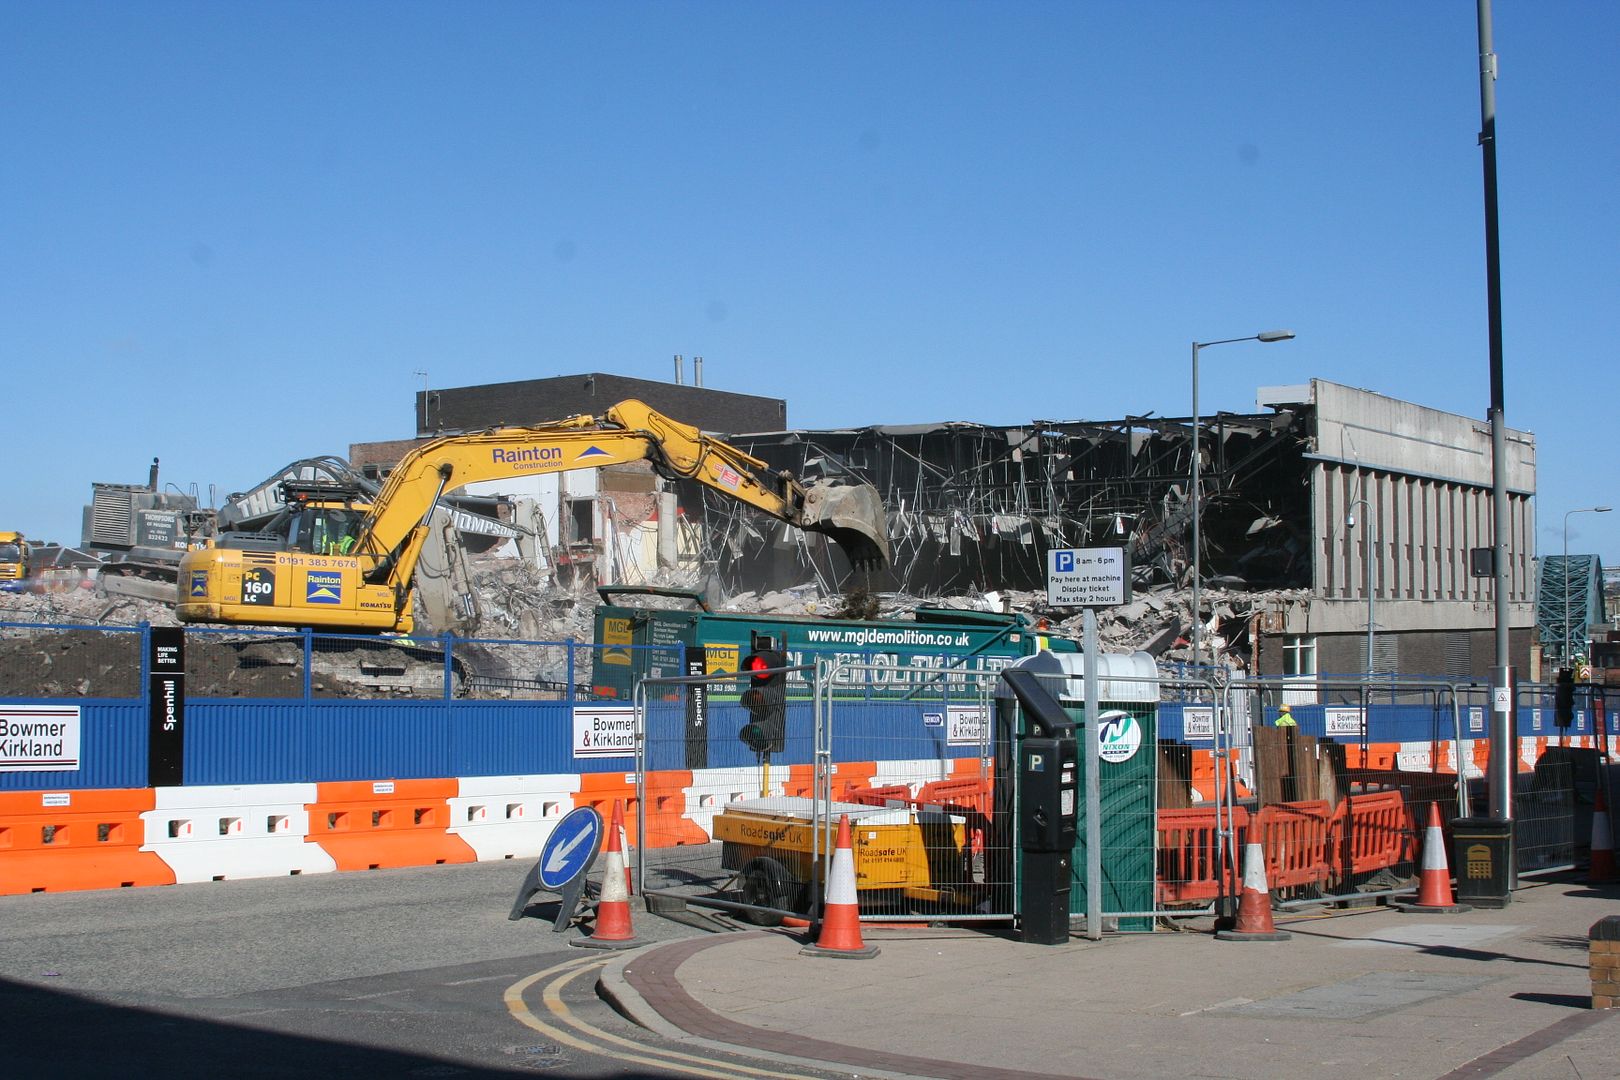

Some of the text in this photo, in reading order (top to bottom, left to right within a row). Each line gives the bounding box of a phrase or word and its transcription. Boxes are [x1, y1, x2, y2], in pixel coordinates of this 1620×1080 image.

[492, 446, 562, 464] Rainton
[513, 460, 563, 471] Construction
[279, 556, 357, 568] 0191 383 7676
[1060, 554, 1071, 571] P
[245, 571, 260, 580] PC
[307, 574, 341, 584] Rainton
[245, 581, 272, 594] 160
[244, 594, 257, 602] LC
[608, 620, 630, 633] MGL
[706, 647, 735, 659] MGL
[164, 681, 177, 731] Spenhill
[694, 688, 703, 727] Spenhill
[0, 719, 66, 737] Bowmer
[583, 730, 634, 747] & Kirkland
[0, 739, 63, 757] Kirkland
[1031, 755, 1042, 770] P
[741, 824, 802, 844] Roadsafe UK
[860, 847, 895, 857] Roadsafe
